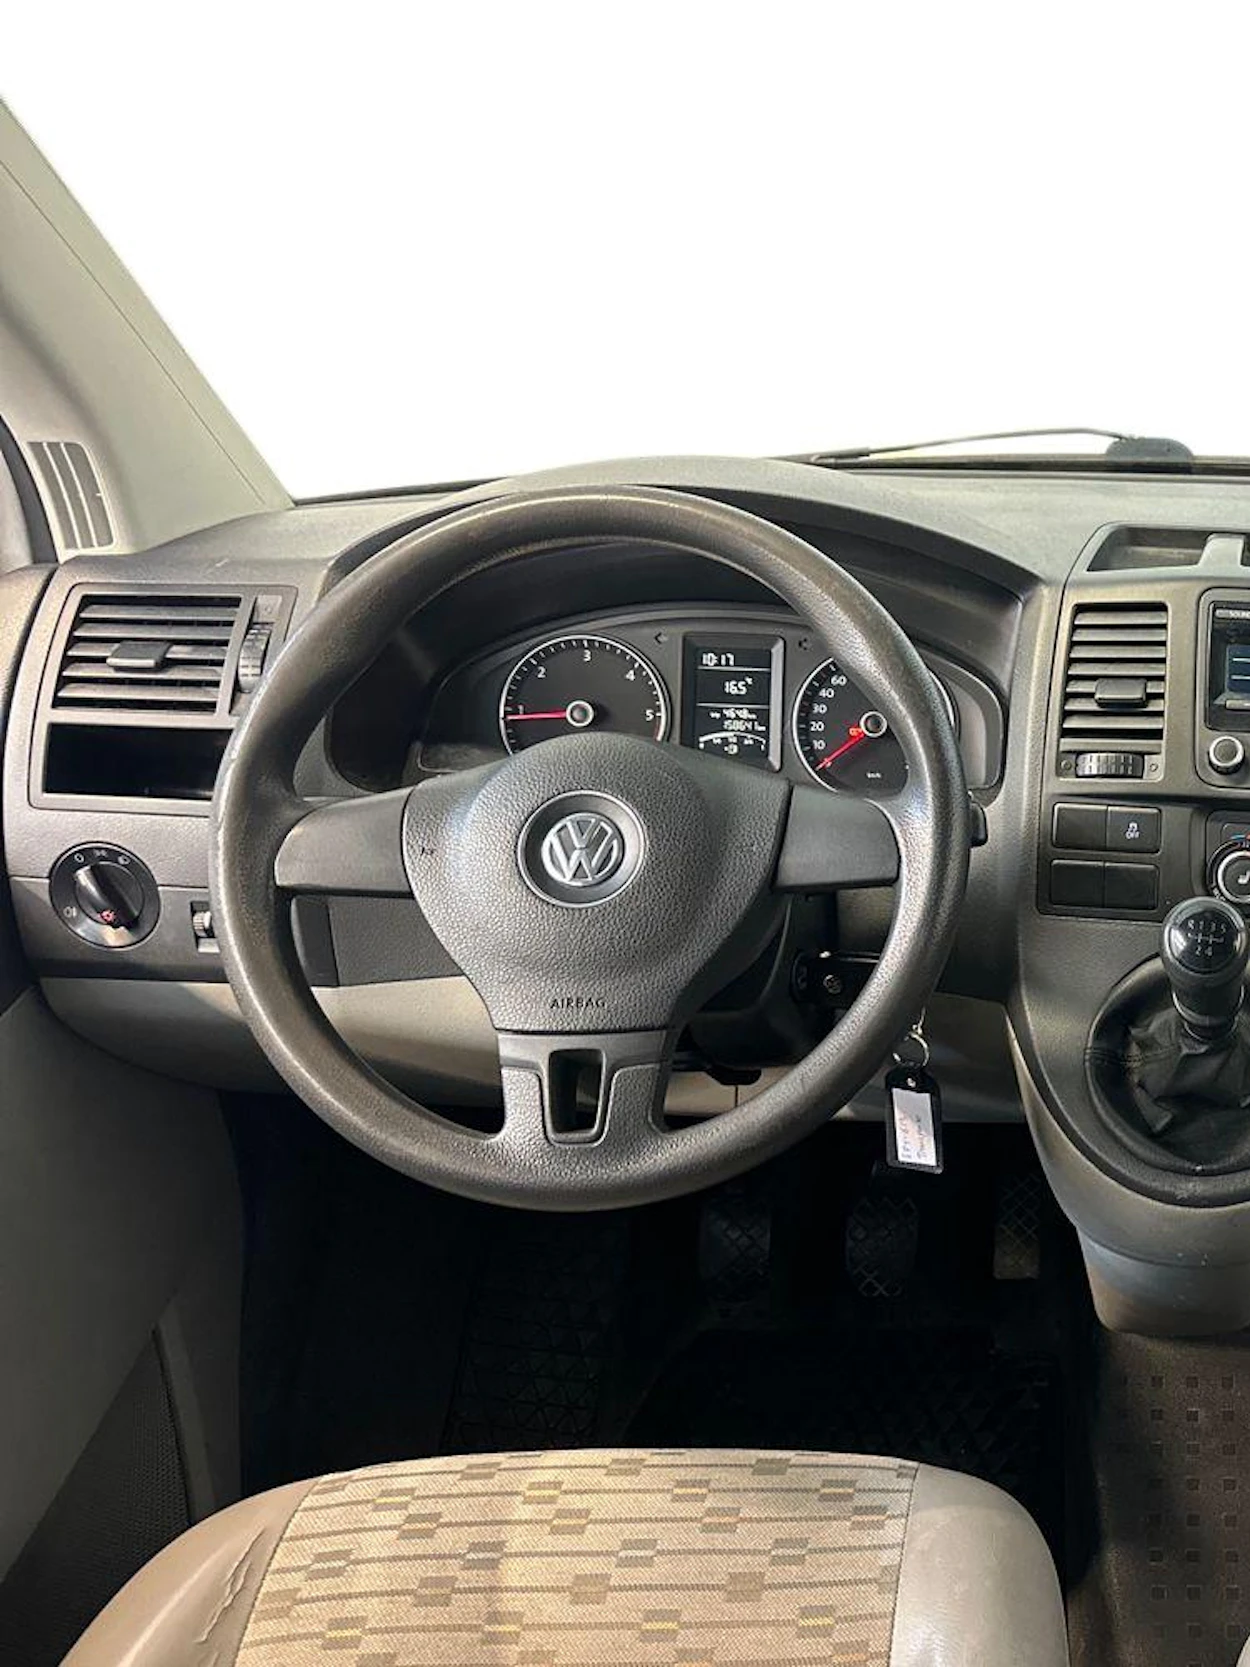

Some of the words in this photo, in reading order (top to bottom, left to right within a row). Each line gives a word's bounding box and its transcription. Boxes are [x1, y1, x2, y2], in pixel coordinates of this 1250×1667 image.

[583, 650, 592, 662] 3
[537, 666, 546, 678] 2
[625, 669, 636, 681] 4
[830, 674, 848, 686] 60
[818, 688, 835, 699] 40
[812, 703, 828, 714] 30
[645, 709, 654, 721] 5
[810, 721, 825, 732] 20
[812, 739, 826, 750] 10
[550, 998, 607, 1009] AIRBAG
